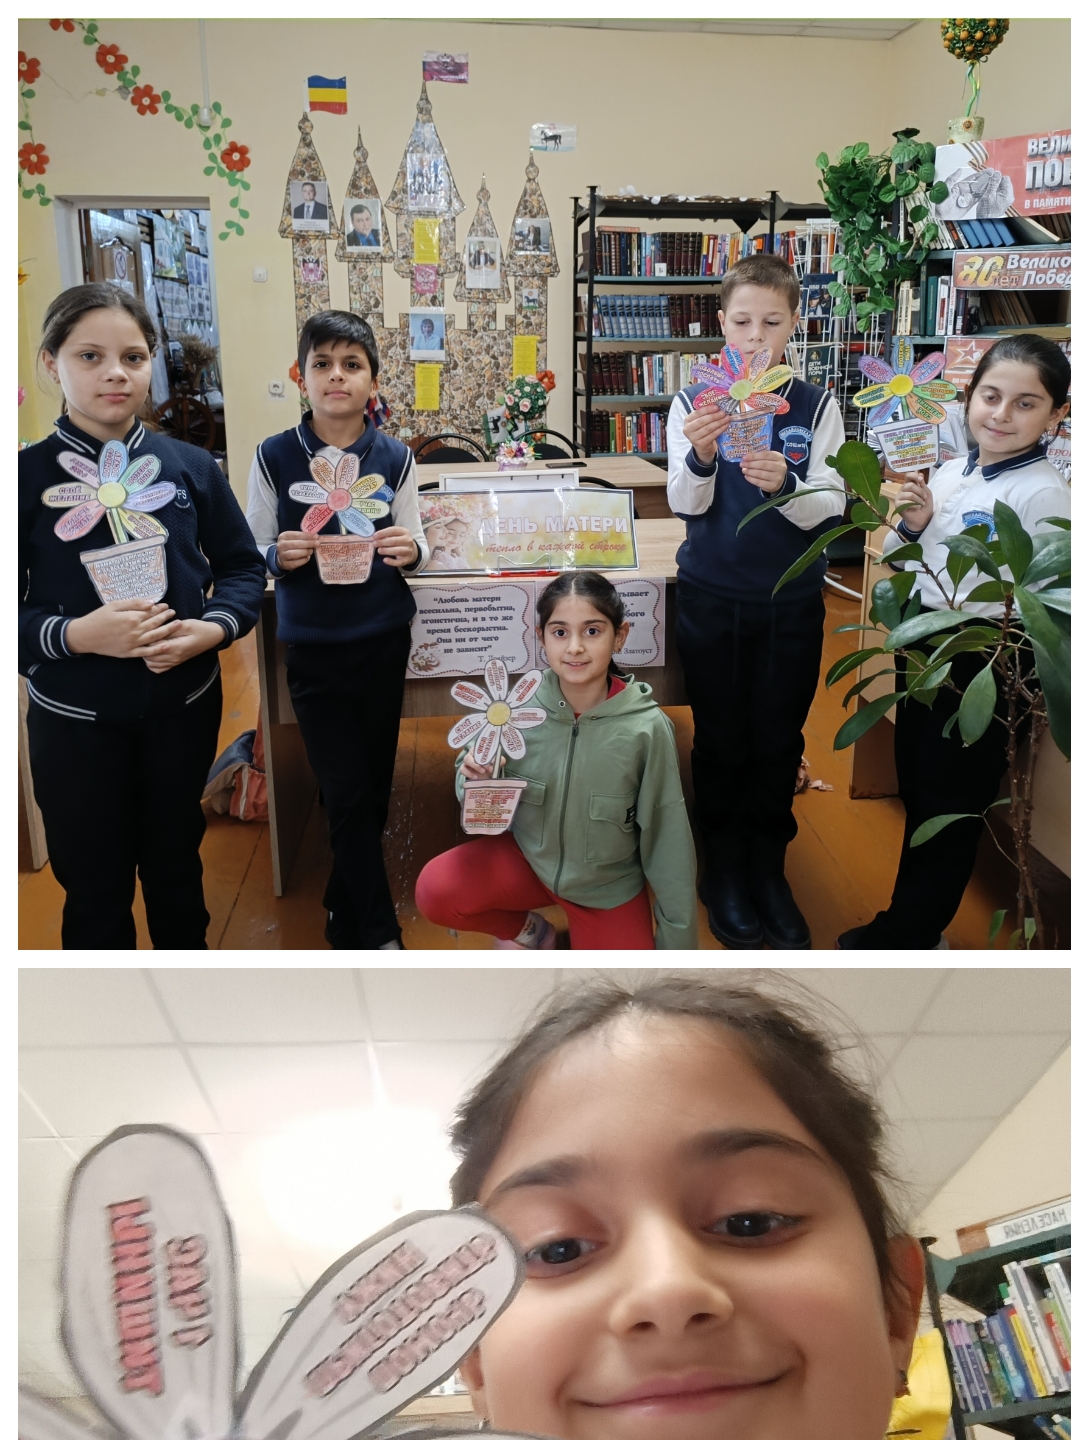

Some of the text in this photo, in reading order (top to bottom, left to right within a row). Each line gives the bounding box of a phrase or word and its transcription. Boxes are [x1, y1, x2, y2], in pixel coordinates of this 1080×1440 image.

[1025, 200, 1030, 209] В
[954, 255, 1006, 287] 80
[176, 489, 187, 499] FS
[477, 516, 628, 538] ДЕНЬ МАТЕРИ
[485, 542, 522, 553] тепло
[526, 540, 534, 552] в
[589, 540, 626, 552] строке
[419, 605, 515, 614] всесильна, первобытна,
[421, 616, 469, 624] эгоистична,
[501, 614, 513, 622] же
[454, 624, 508, 634] бескорыстна.
[481, 635, 499, 643] чего
[443, 646, 453, 654] не
